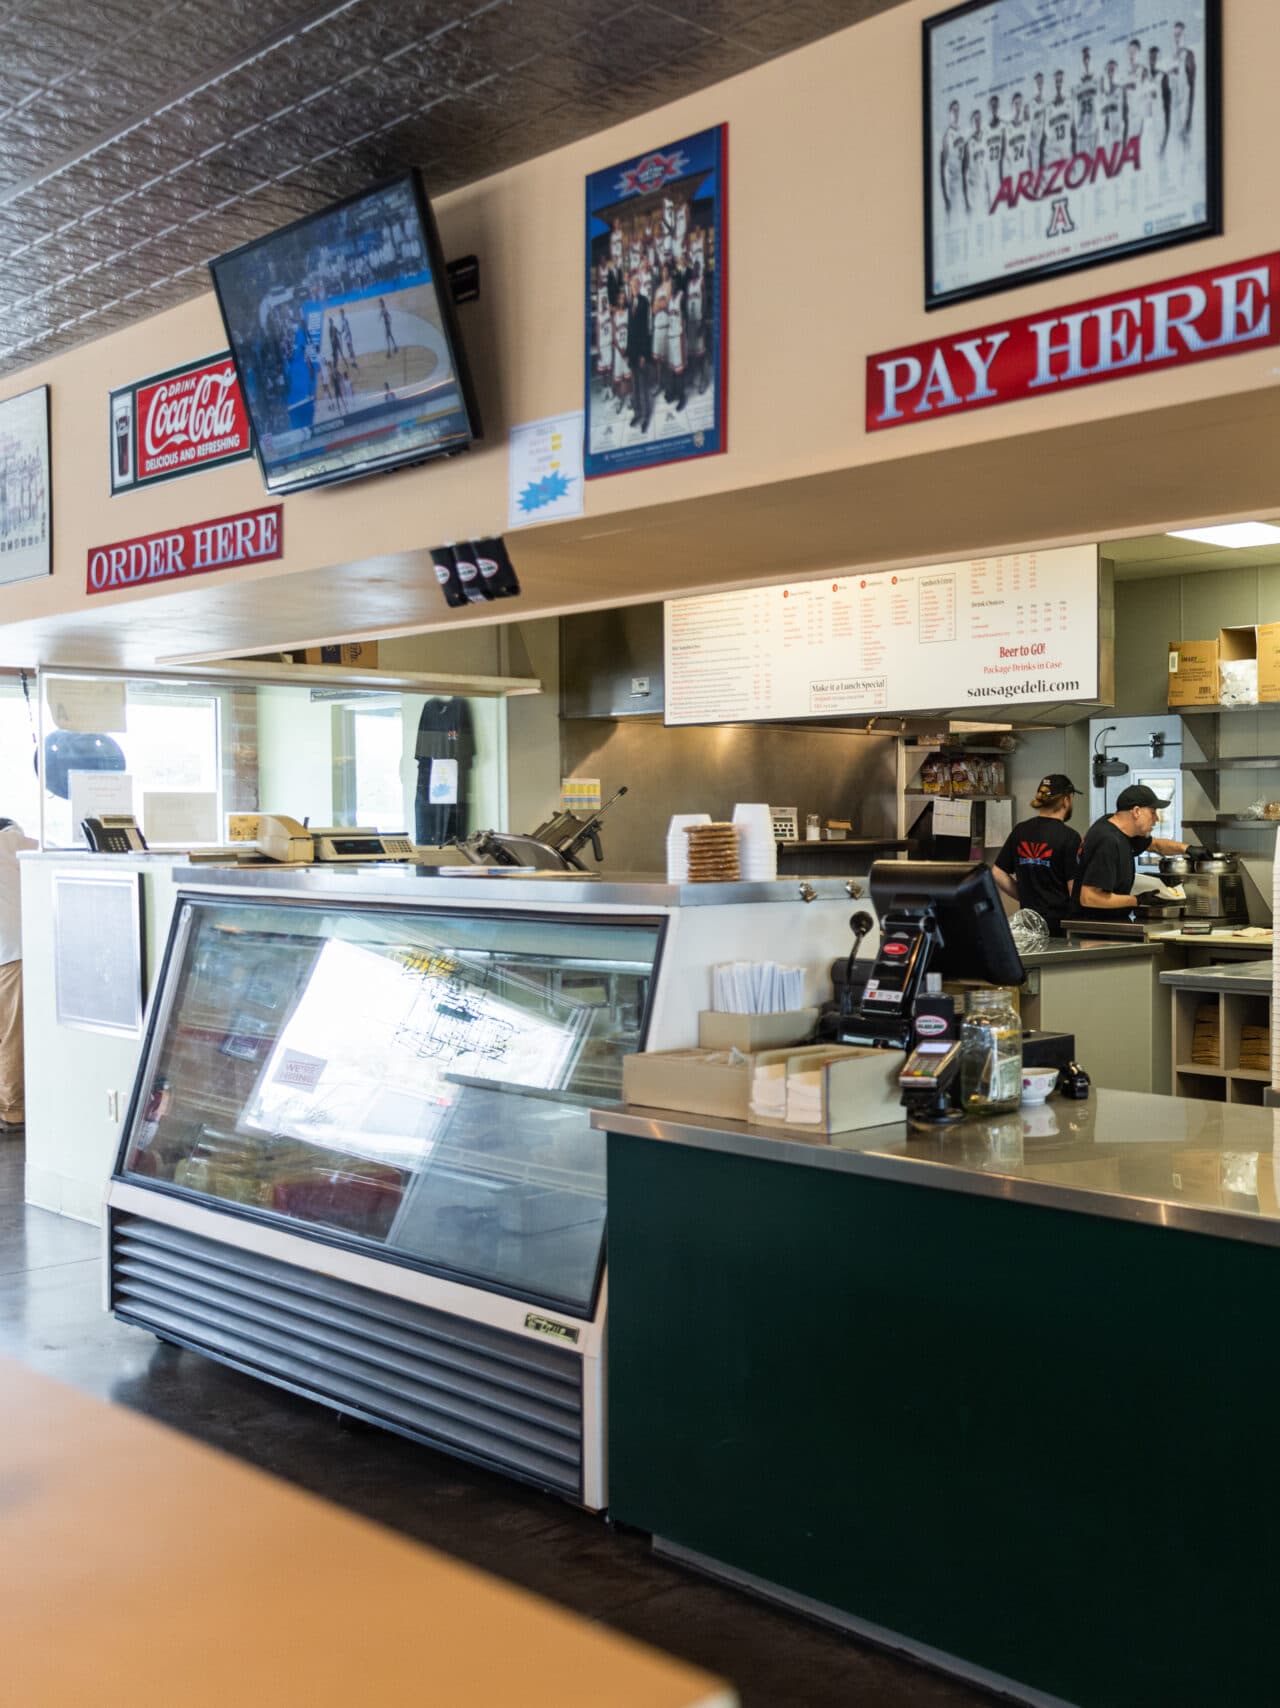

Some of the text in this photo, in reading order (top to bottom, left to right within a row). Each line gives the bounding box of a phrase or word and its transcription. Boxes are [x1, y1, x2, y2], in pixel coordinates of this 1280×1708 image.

[989, 135, 1142, 216] ARIZONA
[876, 266, 1270, 421] PAY HERE
[168, 378, 197, 397] DRINK
[145, 367, 238, 456] Coca-Cola
[146, 434, 240, 471] DELICIOUS AND REFRESHING
[90, 512, 278, 589] ORDER HERE
[999, 642, 1046, 659] Beer to GO!
[983, 664, 1012, 675] Package
[1012, 662, 1037, 672] Drinks
[1046, 661, 1062, 669] Case
[812, 684, 829, 693] Make
[840, 682, 861, 691] Lunch
[861, 679, 885, 691] Special
[967, 679, 1080, 698] sausagedeli.com
